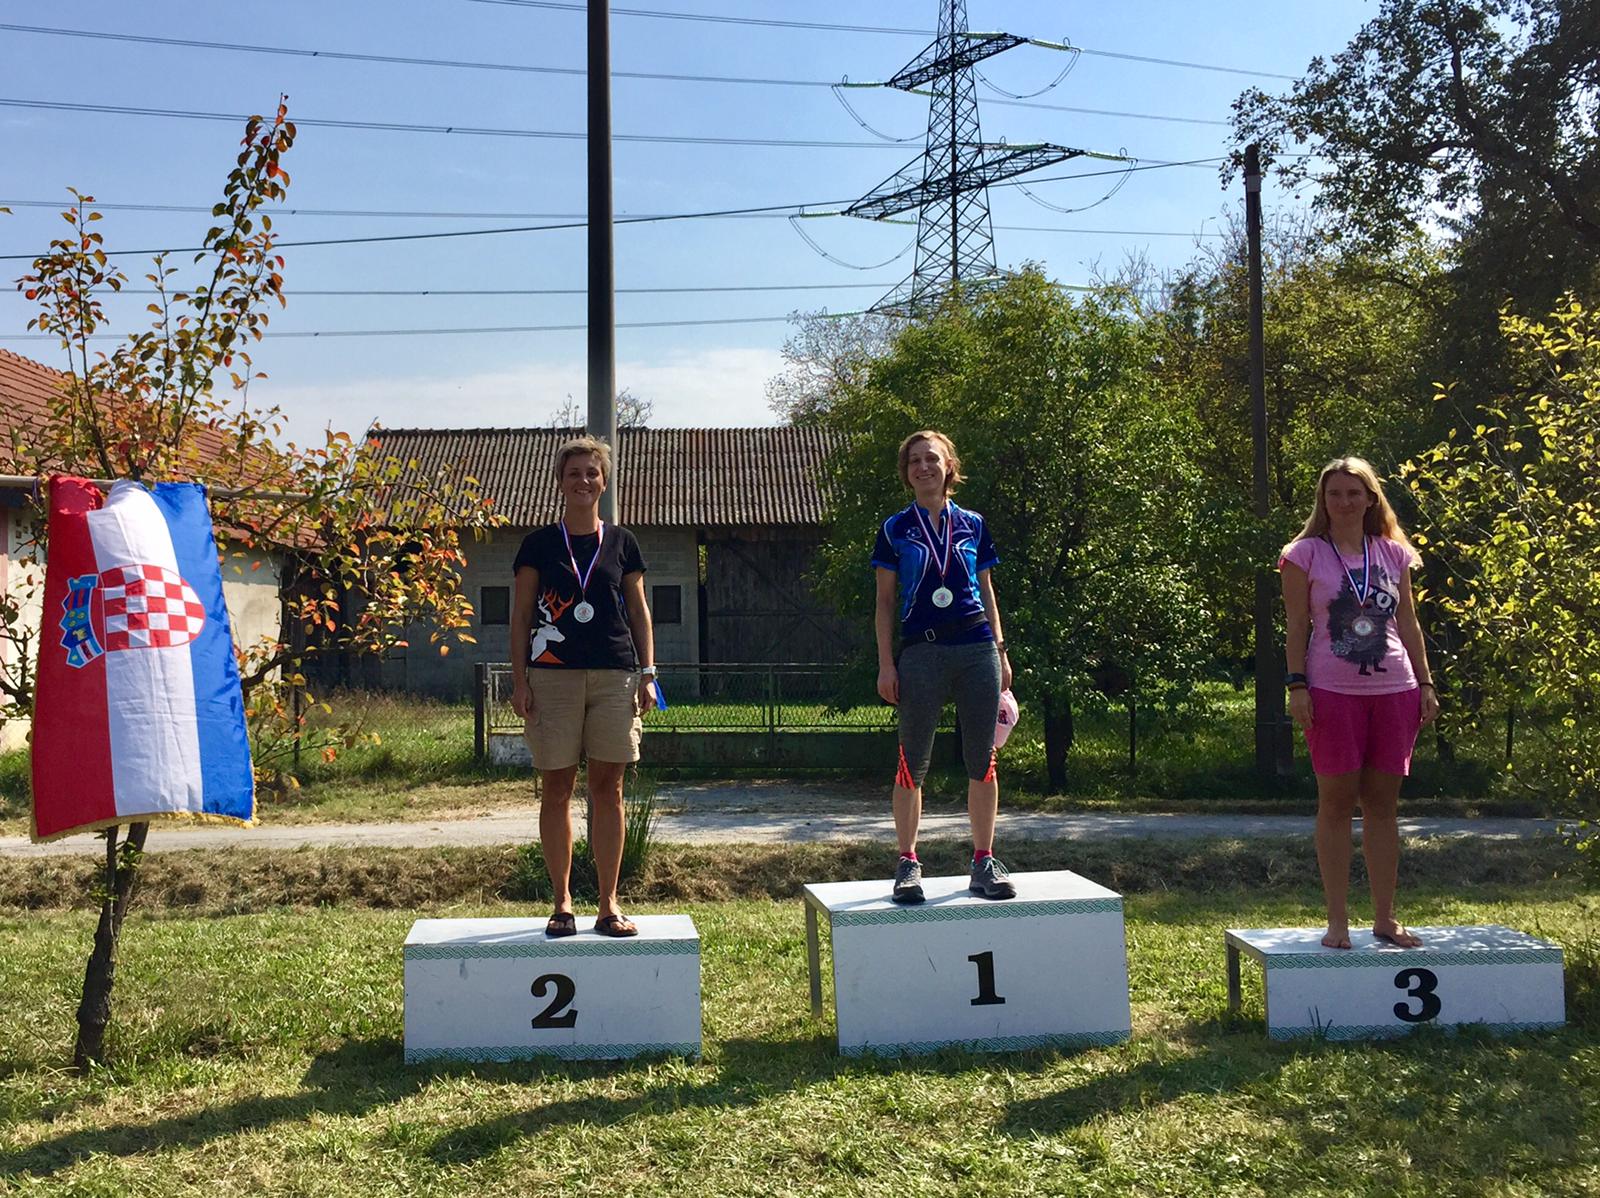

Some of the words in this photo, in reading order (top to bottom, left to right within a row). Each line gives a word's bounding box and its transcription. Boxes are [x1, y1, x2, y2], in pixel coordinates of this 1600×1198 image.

[530, 973, 578, 1029] 2
[967, 951, 1006, 1006] 1
[1393, 967, 1442, 1023] 3
